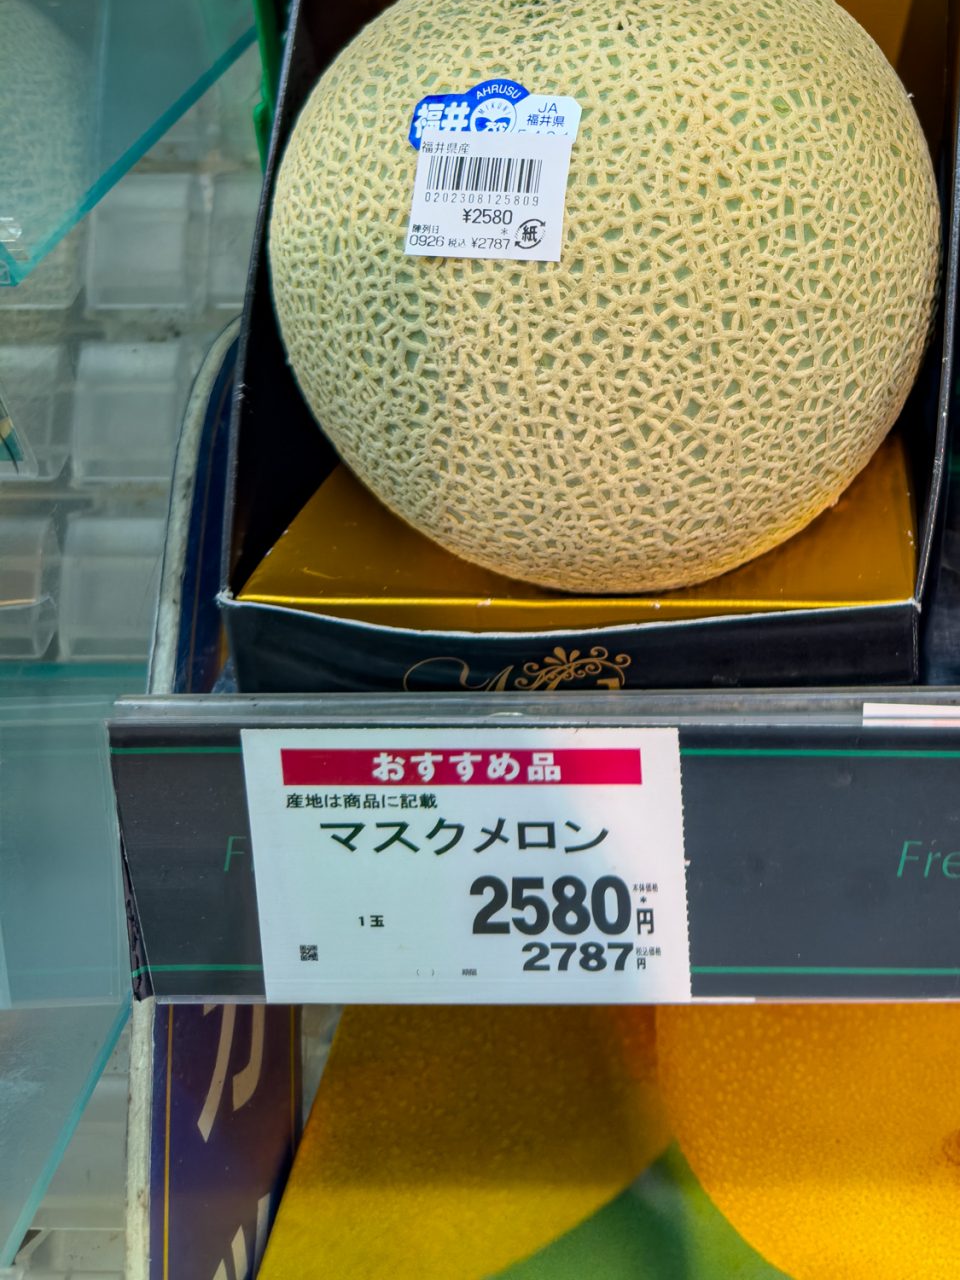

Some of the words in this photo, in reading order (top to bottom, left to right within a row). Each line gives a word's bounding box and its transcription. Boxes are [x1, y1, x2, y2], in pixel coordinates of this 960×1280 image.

[475, 83, 522, 100] AHRUSU
[537, 102, 559, 114] JA
[526, 113, 566, 128] 福井県
[421, 141, 471, 155] 福井県産
[424, 191, 540, 207] 0202308125809
[462, 207, 514, 225] ¥2580
[408, 234, 446, 248] 0926
[471, 236, 511, 251] ¥2787
[521, 224, 539, 243] 紙
[371, 751, 563, 783] おすすめ品
[285, 792, 439, 810] 産地は商品に記載
[319, 816, 610, 857] マスクメロン
[469, 874, 633, 937] 2580
[636, 907, 656, 936] 円
[521, 940, 635, 972] 2787
[636, 957, 647, 971] 円
